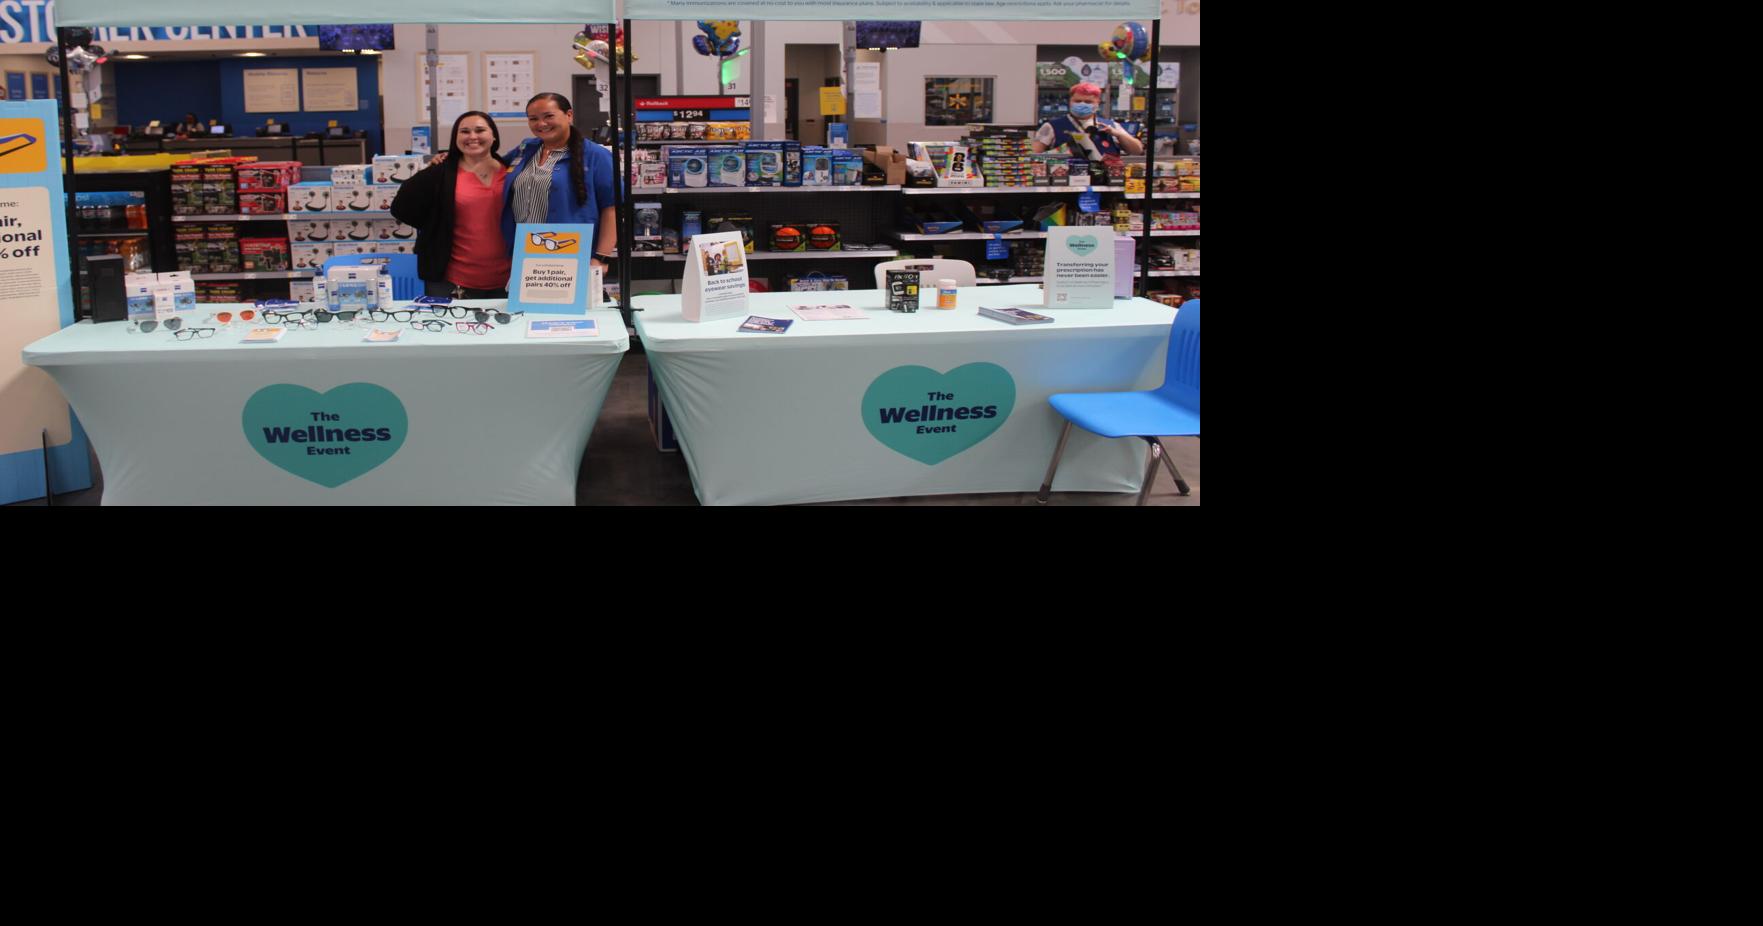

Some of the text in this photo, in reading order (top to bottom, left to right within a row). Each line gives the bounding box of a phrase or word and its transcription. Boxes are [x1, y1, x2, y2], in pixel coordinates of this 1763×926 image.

[12, 245, 41, 258] off
[704, 285, 726, 293] eyewear
[927, 391, 954, 401] The
[310, 411, 340, 422] The
[879, 404, 998, 424] Wellness
[262, 425, 392, 443] Wellness
[916, 424, 957, 434] Event
[306, 446, 351, 456] Event
